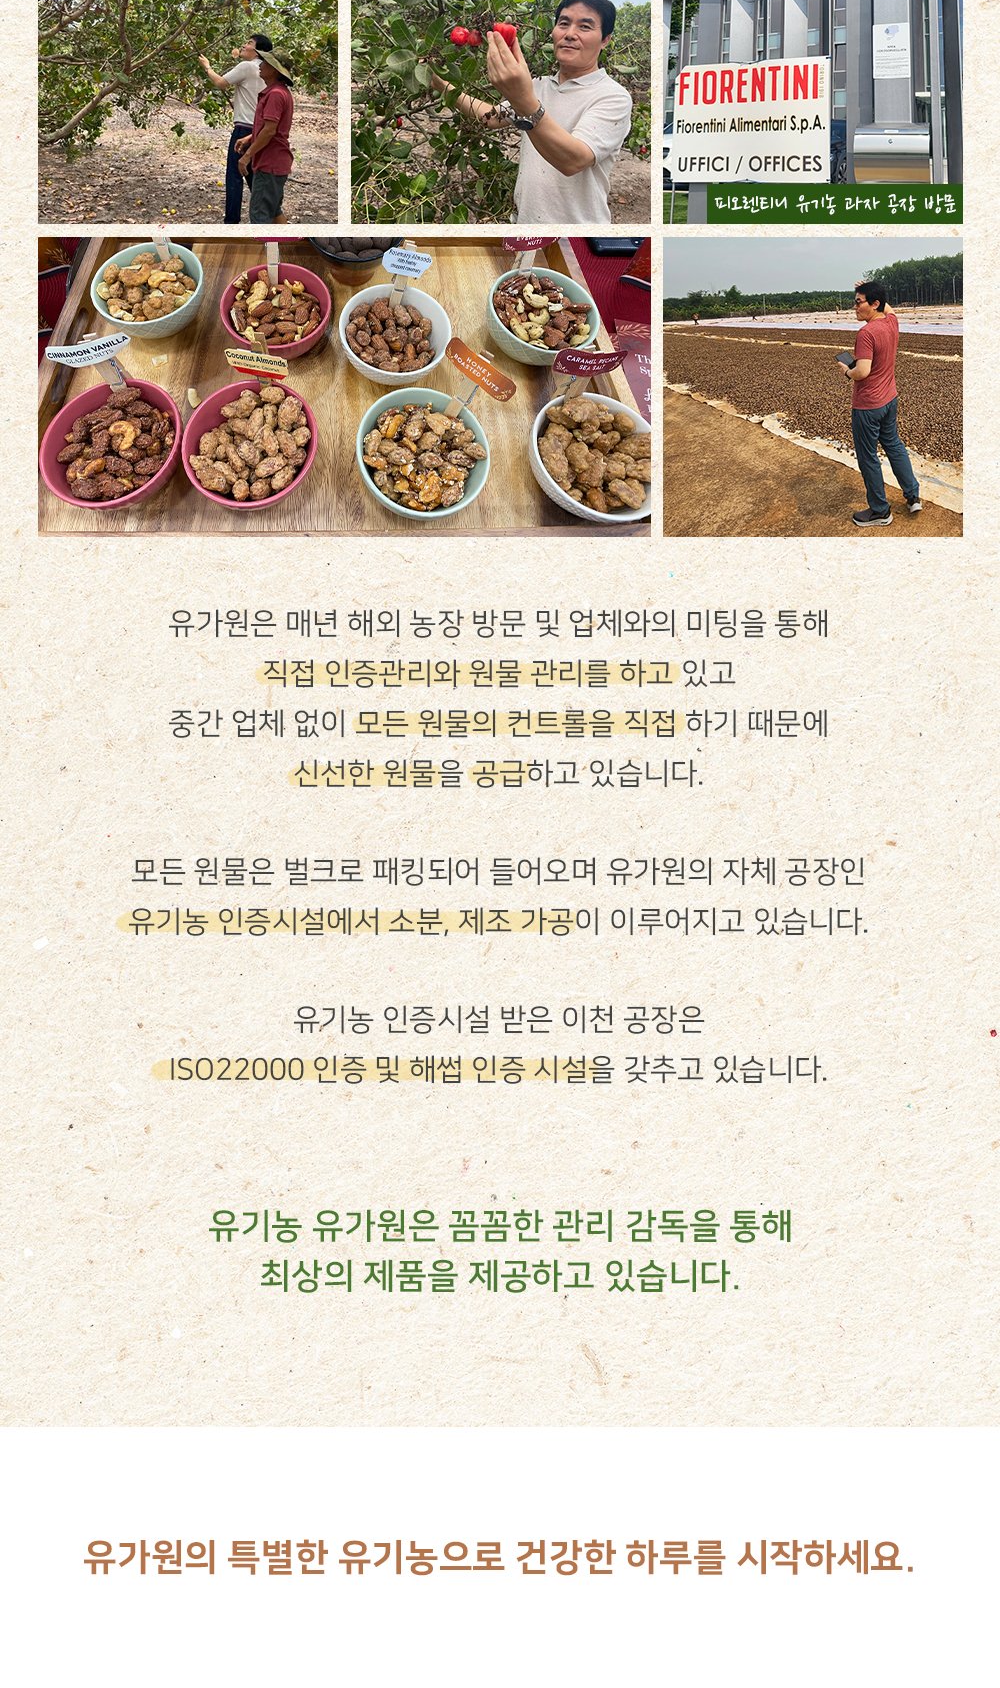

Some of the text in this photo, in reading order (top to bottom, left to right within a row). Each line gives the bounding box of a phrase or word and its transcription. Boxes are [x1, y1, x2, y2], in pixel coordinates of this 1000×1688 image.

[679, 64, 819, 106] FIORENTINI
[676, 115, 826, 134] Fiorentini Alimentari S.p.A.
[678, 157, 729, 173] UFFICI
[749, 155, 823, 172] OFFICES
[47, 335, 128, 359] CINNAMON VANILLA
[226, 351, 255, 362] Coconut
[256, 356, 286, 367] Almonds
[466, 357, 492, 377] HONEY
[453, 353, 499, 392] ROASTED NUTS
